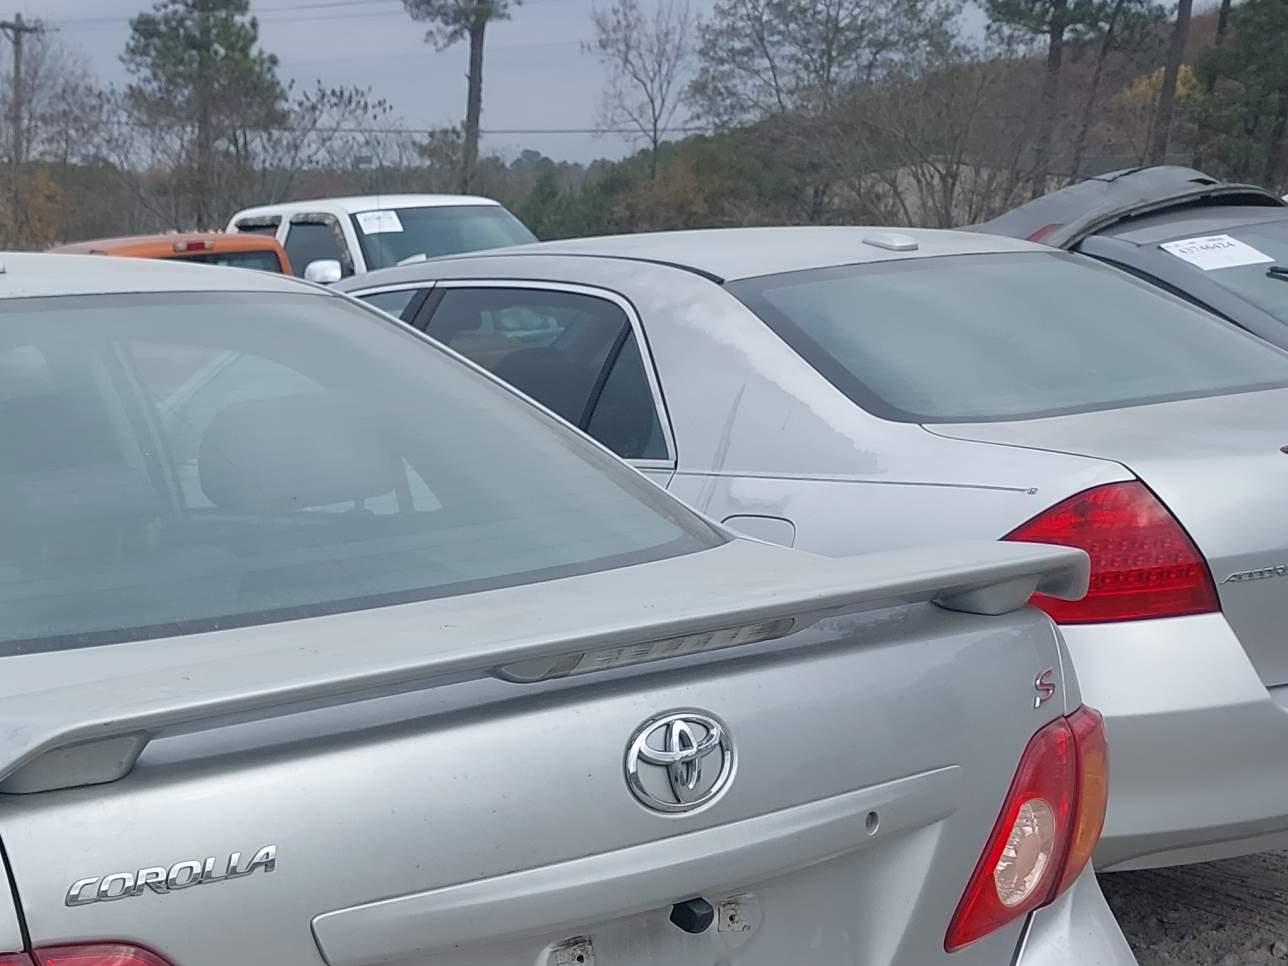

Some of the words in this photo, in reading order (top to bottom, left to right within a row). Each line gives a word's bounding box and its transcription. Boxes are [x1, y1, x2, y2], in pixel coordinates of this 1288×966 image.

[1218, 564, 1288, 585] ACCOR
[1033, 666, 1056, 709] S
[64, 844, 277, 907] COROLLA
